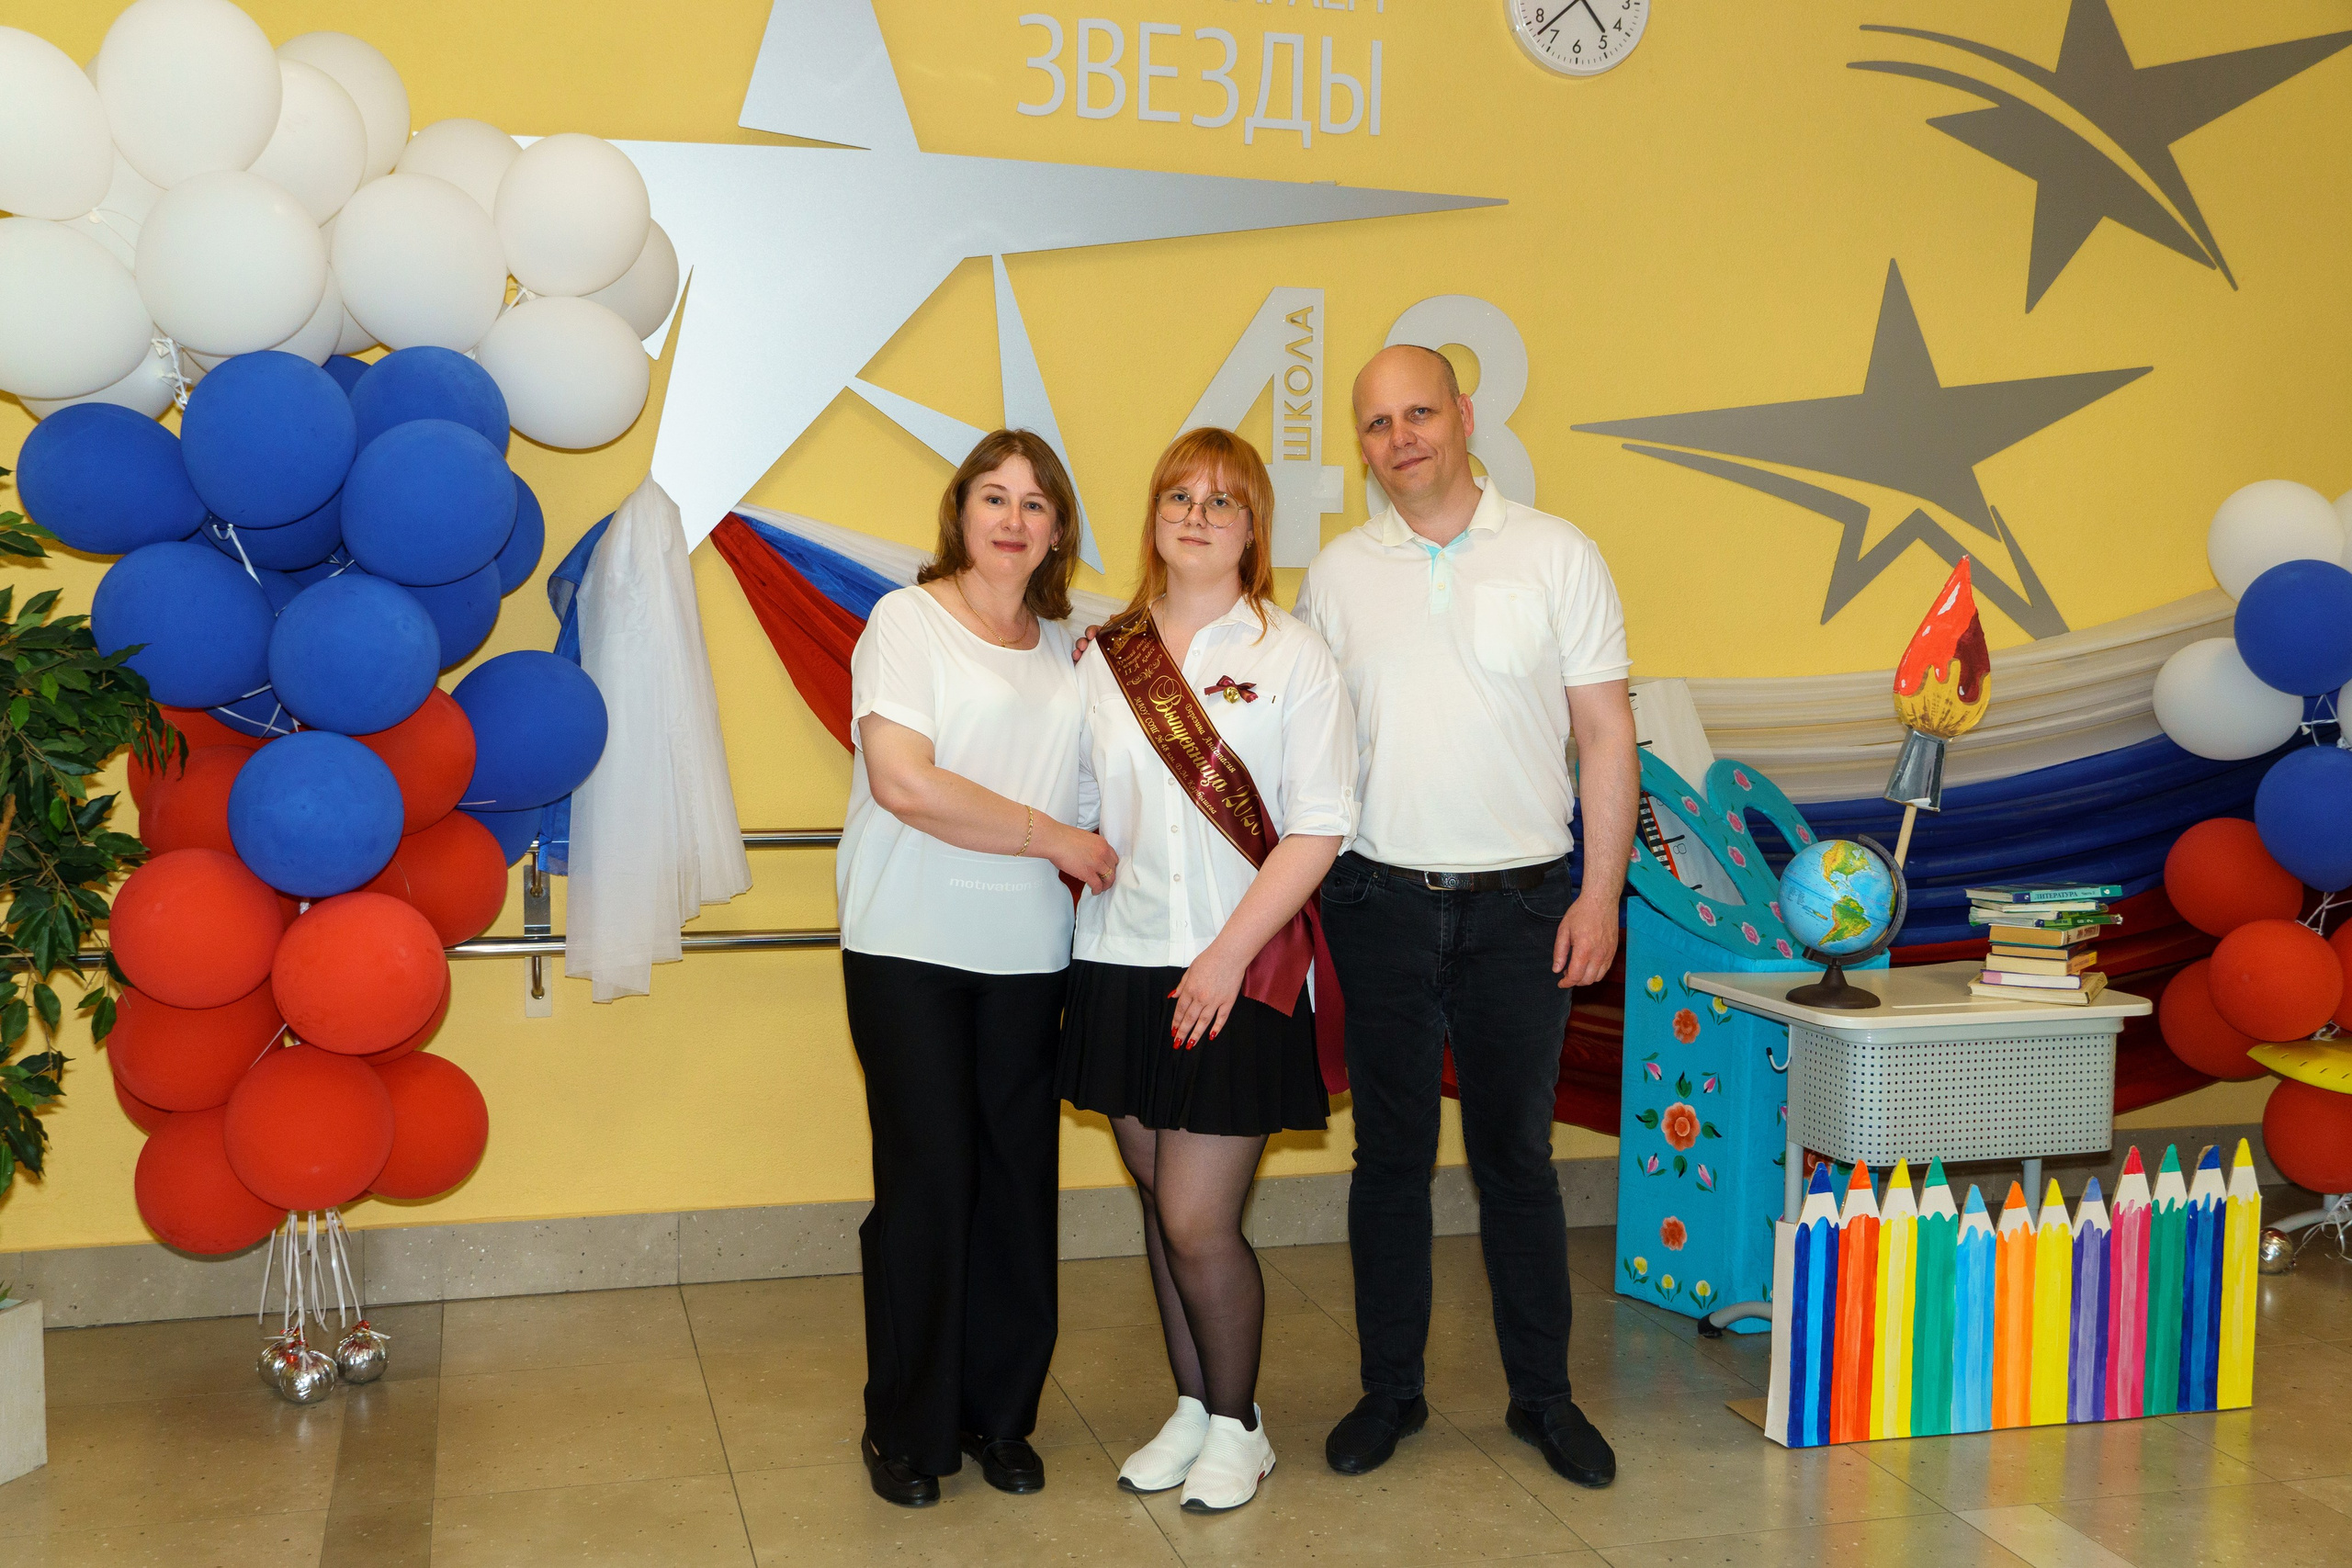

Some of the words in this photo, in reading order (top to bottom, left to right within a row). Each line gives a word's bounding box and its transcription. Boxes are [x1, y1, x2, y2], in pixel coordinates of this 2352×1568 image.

[1535, 7, 1544, 23] 8
[1612, 17, 1623, 32] 4
[1550, 28, 1560, 44] 7
[1598, 35, 1608, 50] 5
[1572, 39, 1581, 54] 6
[1015, 13, 1383, 149] ЗВЕЗДЫ
[1283, 305, 1314, 461] ШКОЛА
[1145, 717, 1160, 734] СОШ
[1160, 741, 1170, 752] 48
[1148, 674, 1228, 793] Выпускница
[1202, 736, 1237, 773] Анастасия
[949, 877, 1032, 892] motivation
[2034, 891, 2078, 900] ЛИТЕРАТУРА
